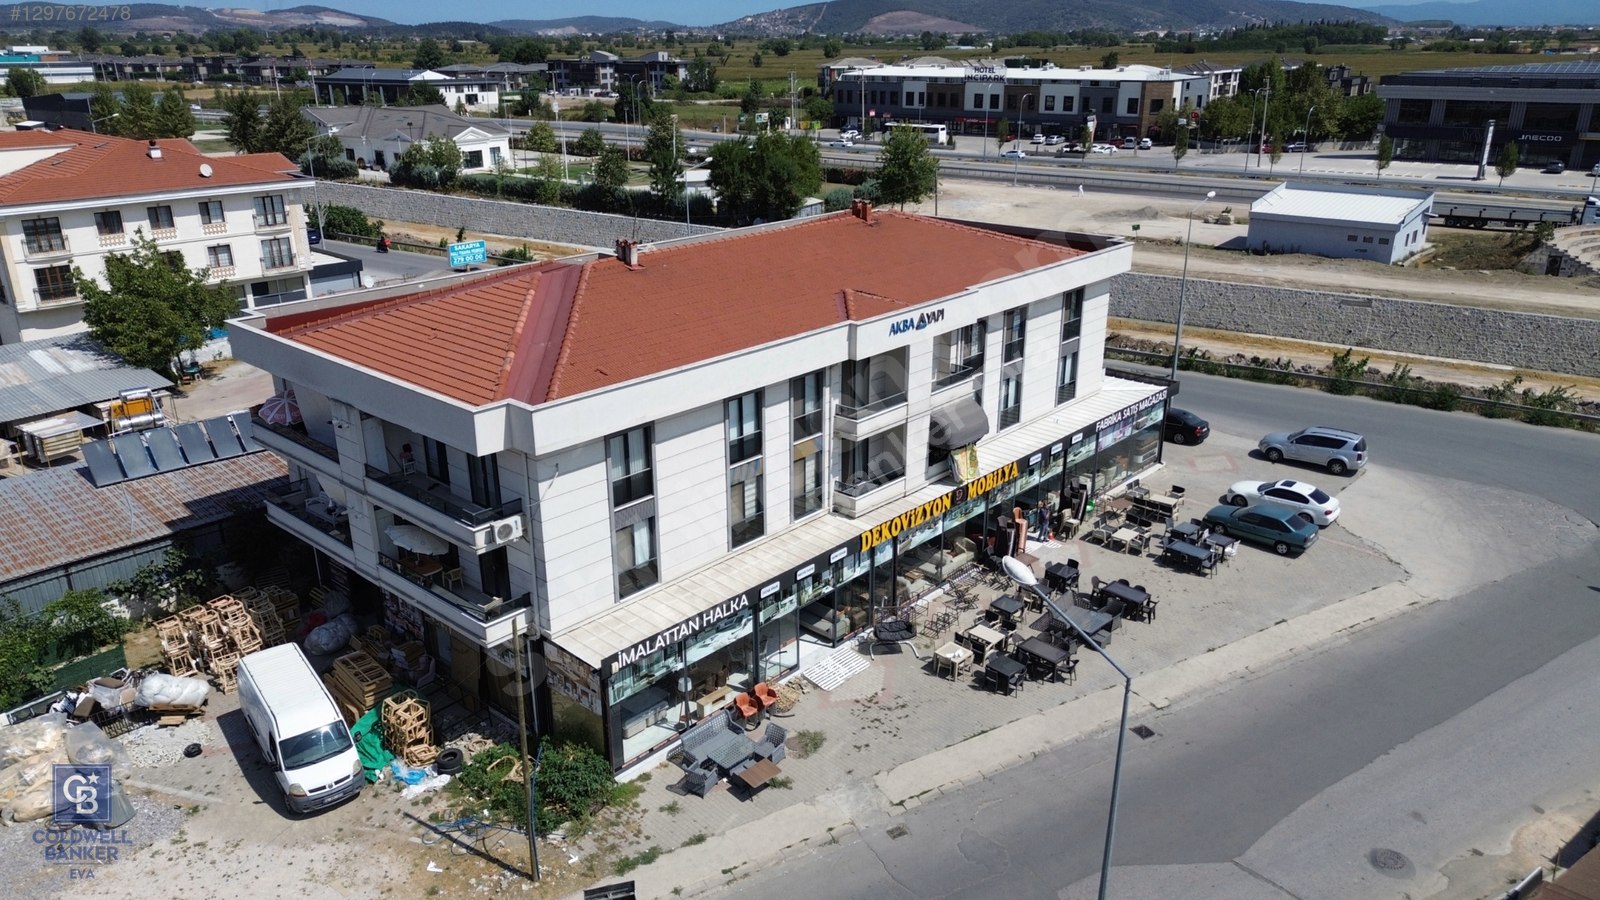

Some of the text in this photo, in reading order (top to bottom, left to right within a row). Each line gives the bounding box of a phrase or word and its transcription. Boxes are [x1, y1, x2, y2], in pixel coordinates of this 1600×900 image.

[454, 242, 480, 250] SAKARYA
[889, 308, 944, 336] AKBA YAPI
[618, 594, 749, 669] İMALATTAN HALKA
